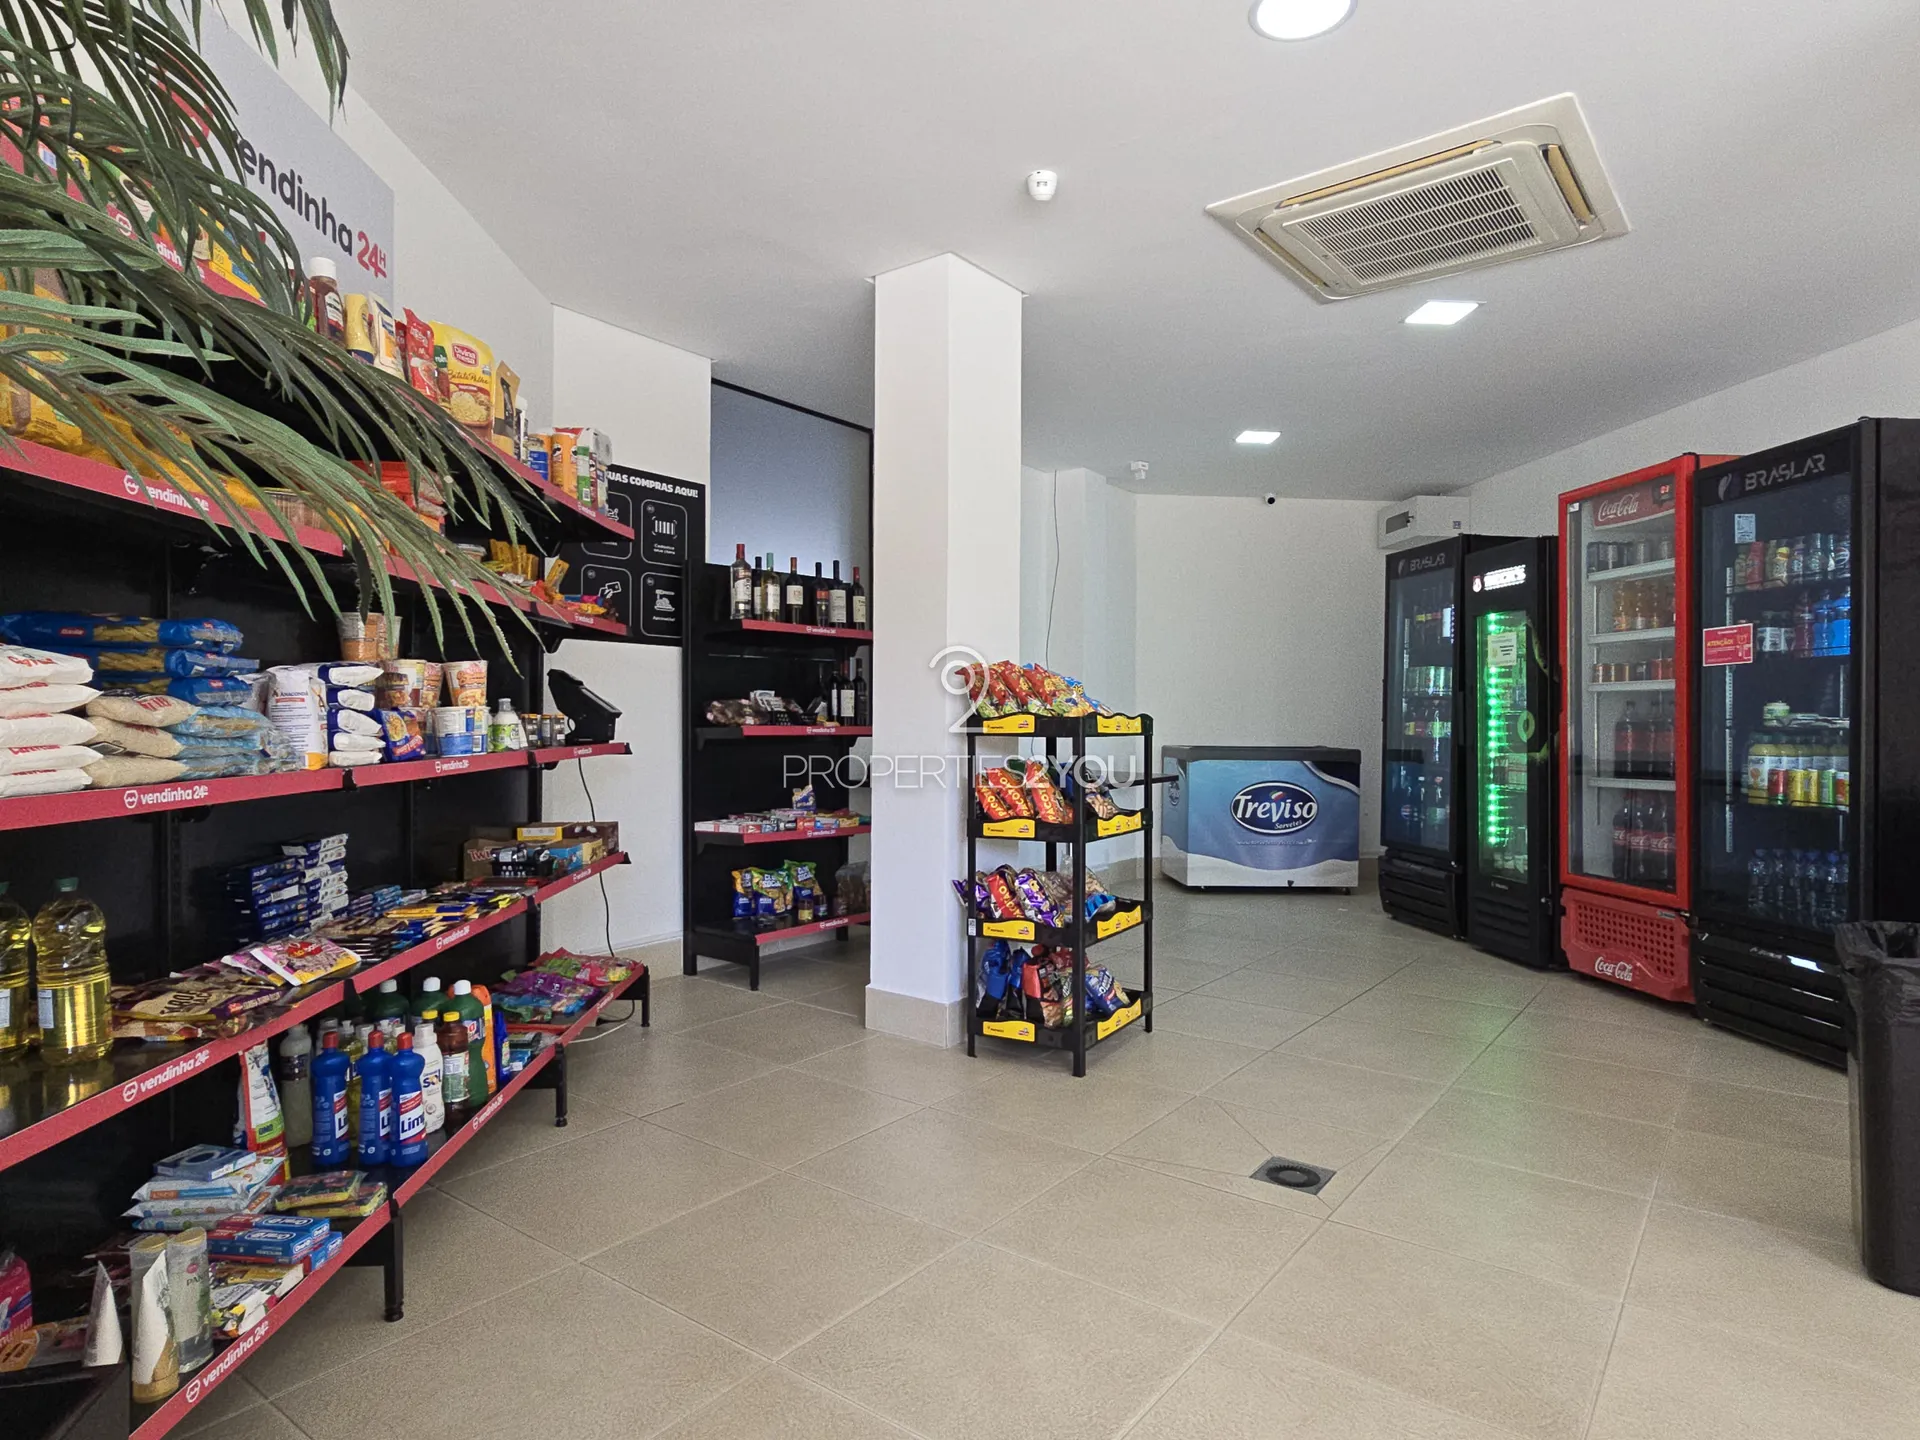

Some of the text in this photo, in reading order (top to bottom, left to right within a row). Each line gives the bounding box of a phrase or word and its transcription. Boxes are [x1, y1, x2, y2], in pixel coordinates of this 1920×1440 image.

[238, 138, 388, 279] endinha 24H
[1744, 452, 1826, 492] BRASLAR
[629, 476, 674, 493] COMPRAS
[674, 485, 699, 498] AQUI!
[1409, 552, 1446, 573] BRASLAR
[140, 787, 193, 805] vendinha
[1233, 795, 1318, 823] Treviso
[1274, 819, 1303, 830] Sorvetes
[468, 847, 494, 862] TWI
[140, 1059, 194, 1093] vendinha
[202, 1335, 254, 1388] vendinha
